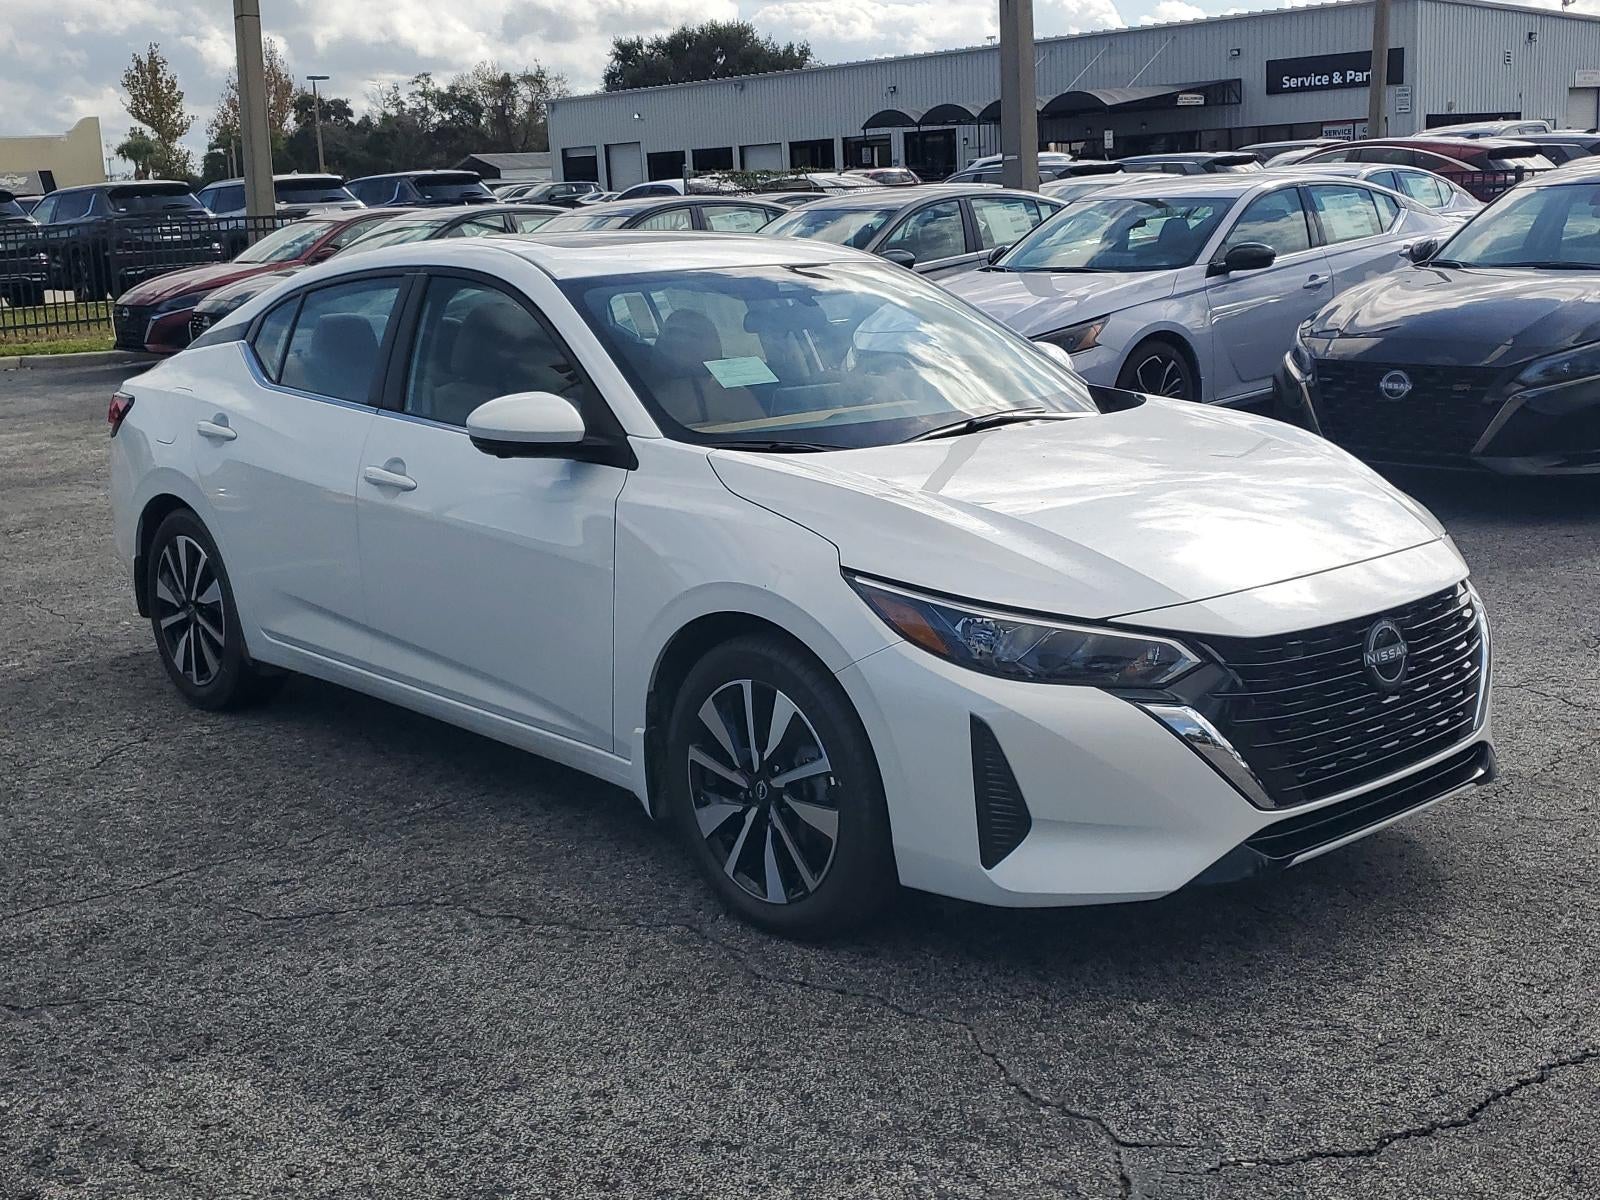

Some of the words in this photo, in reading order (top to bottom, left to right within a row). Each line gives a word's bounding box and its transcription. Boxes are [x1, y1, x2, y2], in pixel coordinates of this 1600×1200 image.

[1282, 73, 1329, 88] Service
[1332, 71, 1343, 84] &
[1346, 69, 1371, 83] Par
[1324, 128, 1352, 137] SERVICE
[1366, 644, 1408, 665] NISSAN
